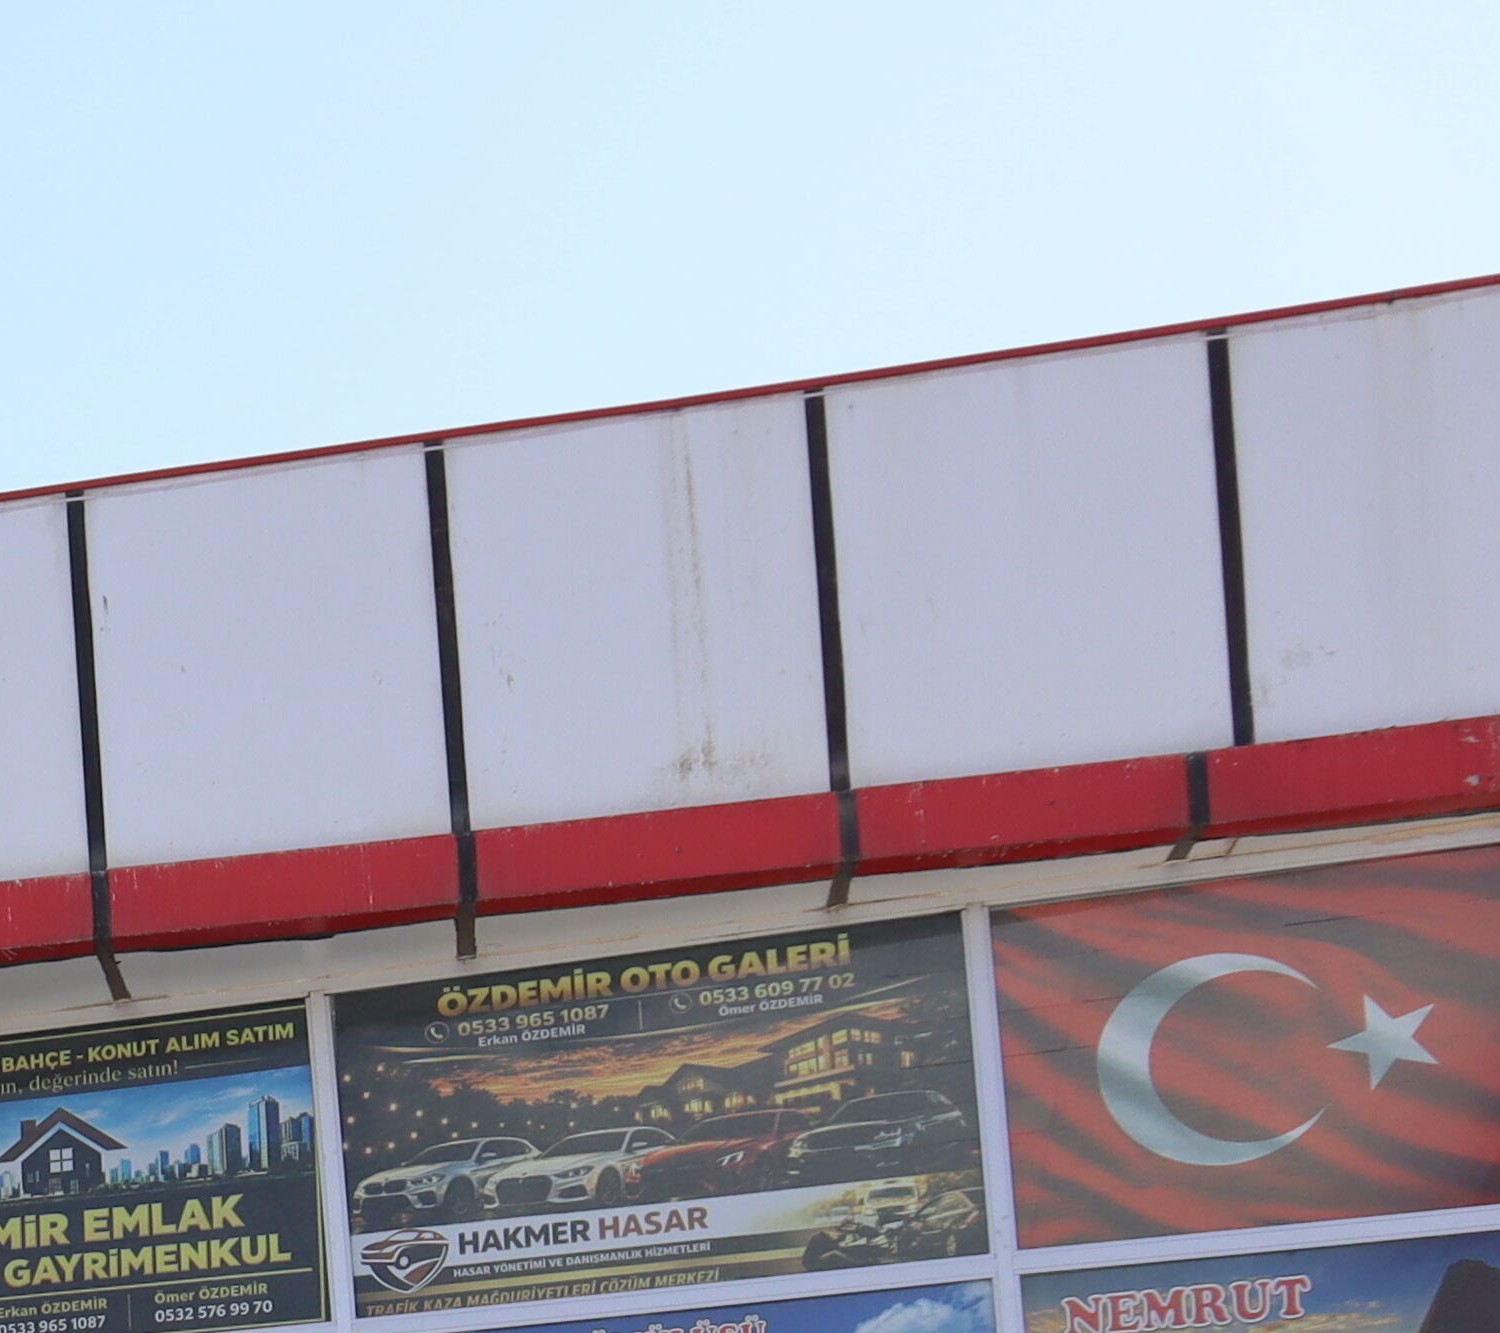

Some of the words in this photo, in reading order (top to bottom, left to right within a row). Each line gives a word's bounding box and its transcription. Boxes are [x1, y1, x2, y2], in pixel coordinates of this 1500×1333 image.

[436, 967, 612, 1016] ÖZDEMİR
[620, 959, 700, 992] OTO
[708, 933, 851, 983] GALERİ
[700, 987, 750, 1007] 0533
[754, 981, 794, 1000] 609
[799, 976, 825, 994] 77
[828, 973, 855, 991] 02
[458, 1017, 512, 1037] 0533
[515, 1012, 555, 1031] 965
[560, 1004, 609, 1026] 1087
[478, 1034, 518, 1048] Erkan
[521, 1023, 586, 1041] ÖZDEMİR
[2, 1050, 71, 1073] BAHÇE
[88, 1040, 159, 1062] KONUT
[165, 1031, 220, 1053] ALIM
[226, 1022, 294, 1045] SATIM
[29, 1065, 122, 1093] değerinde
[128, 1060, 178, 1079] satın!
[84, 1193, 246, 1242] EMLAK
[458, 1219, 591, 1256] HAKMER
[599, 1206, 709, 1241] HASAR
[4, 1232, 292, 1289] GAYRİMENKUL
[453, 1265, 491, 1278] HASAR
[549, 1256, 563, 1268] VE
[41, 1296, 108, 1314] ÖZDEMİR
[155, 1288, 195, 1304] Ömer
[199, 1282, 268, 1300] ÖZDEMİR
[38, 1318, 67, 1333] 965
[71, 1315, 105, 1331] 1087
[155, 1307, 194, 1323] 0532
[198, 1304, 226, 1319] 576
[228, 1302, 249, 1316] 99
[252, 1299, 273, 1314] 70
